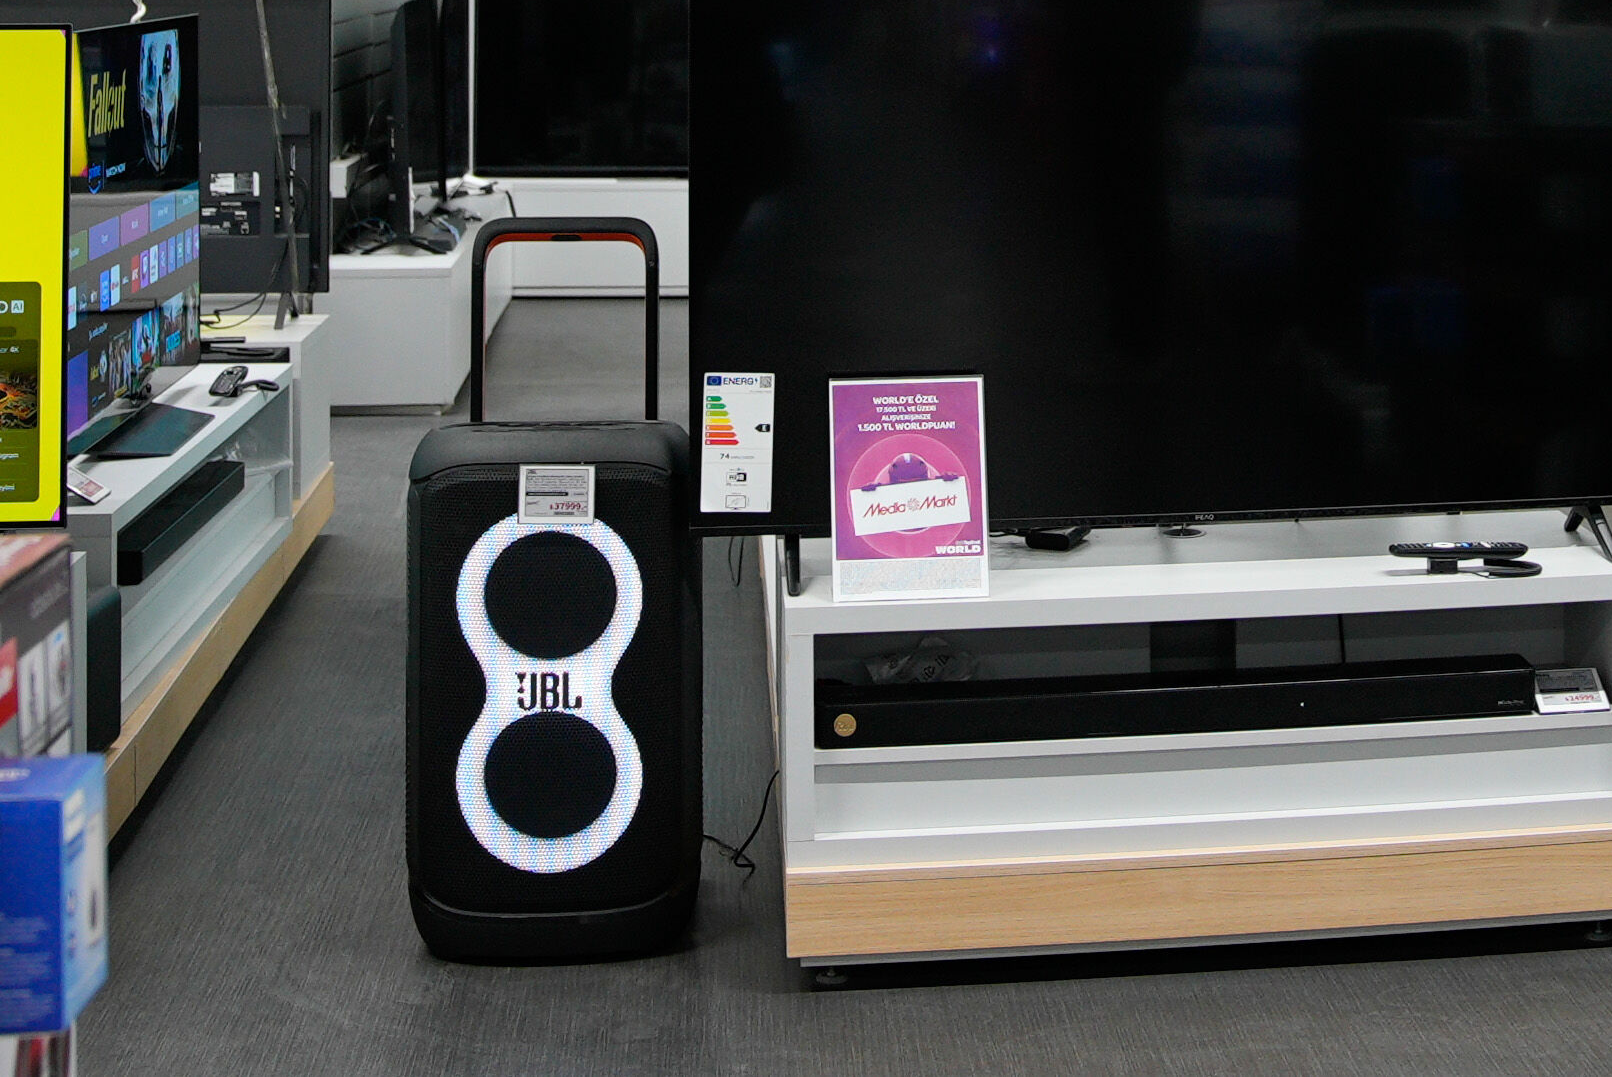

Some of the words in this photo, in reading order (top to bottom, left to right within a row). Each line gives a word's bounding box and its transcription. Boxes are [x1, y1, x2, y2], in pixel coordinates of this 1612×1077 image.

[88, 69, 127, 138] Fallout
[722, 376, 755, 386] ENERG
[915, 394, 939, 404] ÖZEL
[883, 423, 894, 431] TL
[863, 502, 906, 519] Media
[919, 495, 958, 510] Markt
[935, 544, 981, 555] WORLD
[517, 671, 584, 712] JBL
